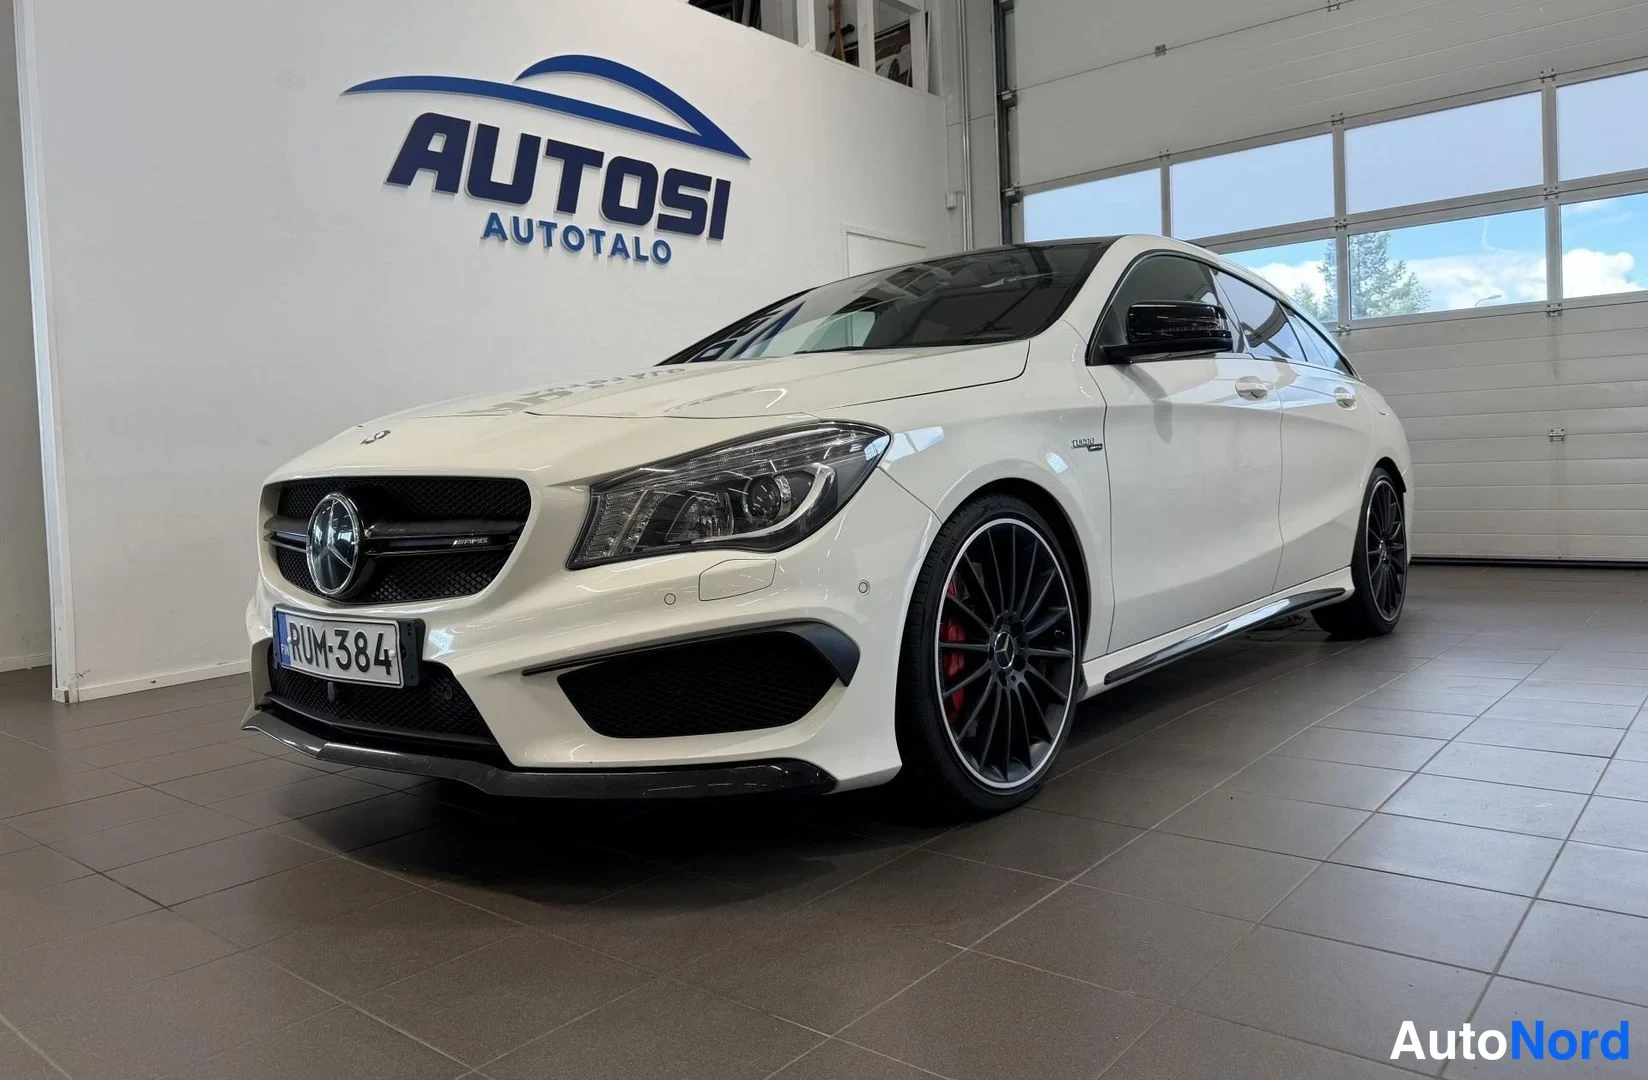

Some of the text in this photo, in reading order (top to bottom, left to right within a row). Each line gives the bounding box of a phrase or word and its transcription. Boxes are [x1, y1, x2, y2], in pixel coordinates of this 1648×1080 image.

[386, 112, 731, 240] AUTOSI
[483, 212, 672, 265] AUTOTALO
[289, 622, 392, 675] RUM-384
